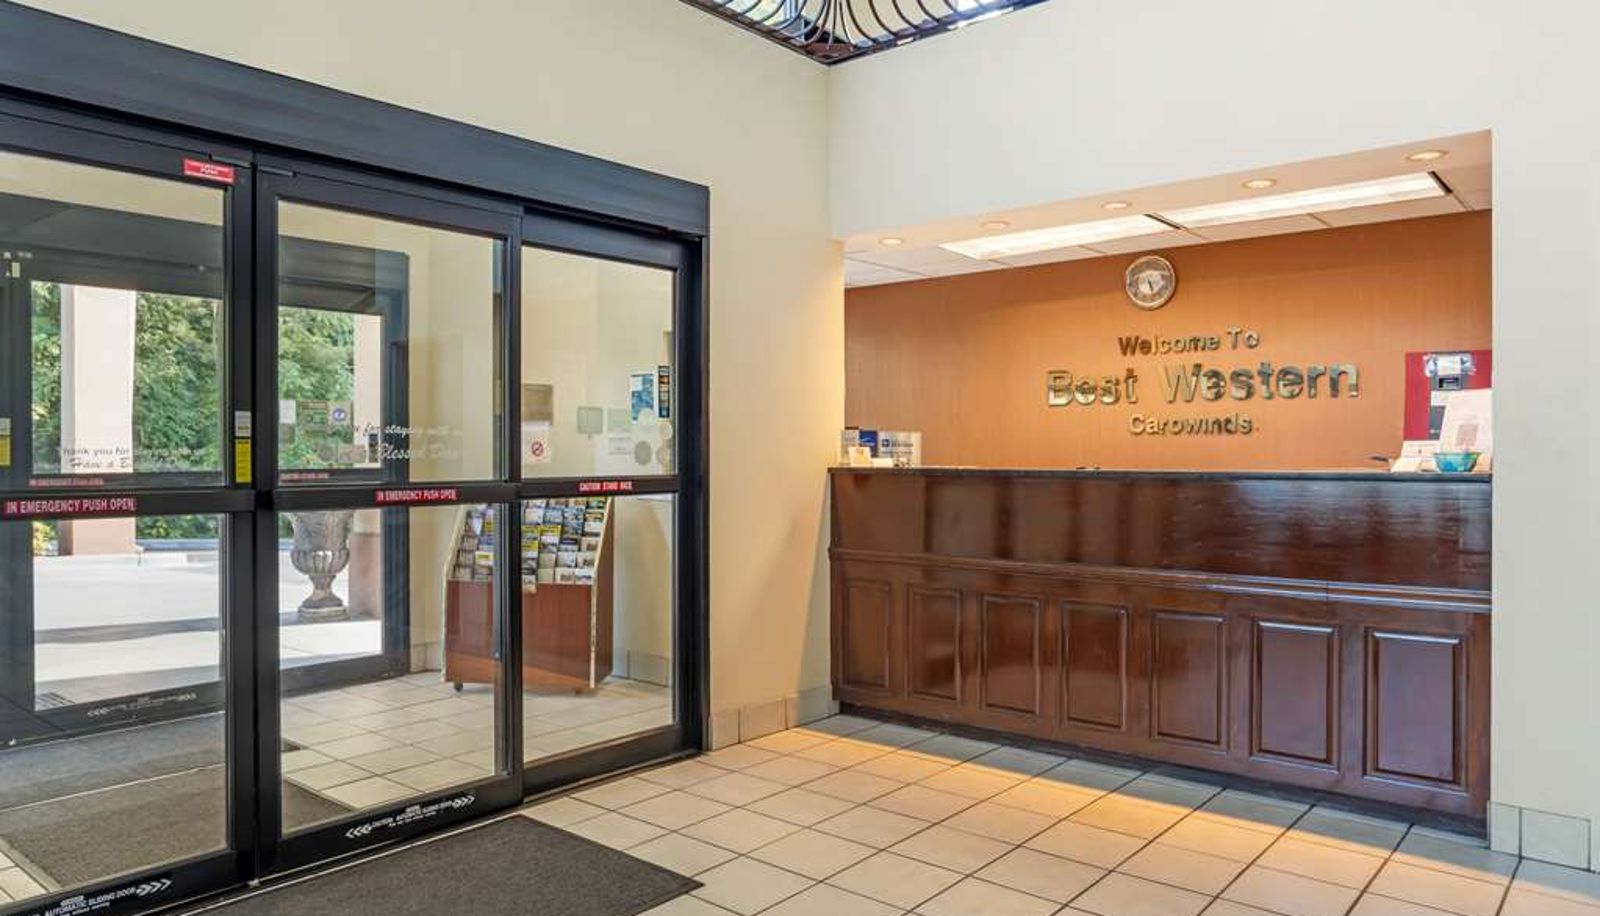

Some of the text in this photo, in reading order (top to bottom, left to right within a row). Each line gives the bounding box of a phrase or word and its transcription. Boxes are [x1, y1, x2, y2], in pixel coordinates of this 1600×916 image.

[1118, 325, 1260, 356] Welcome To
[1047, 360, 1360, 406] Best Western
[1128, 412, 1253, 435] Carowinds
[7, 498, 135, 513] IN EMERGENCY PUSH OPEN
